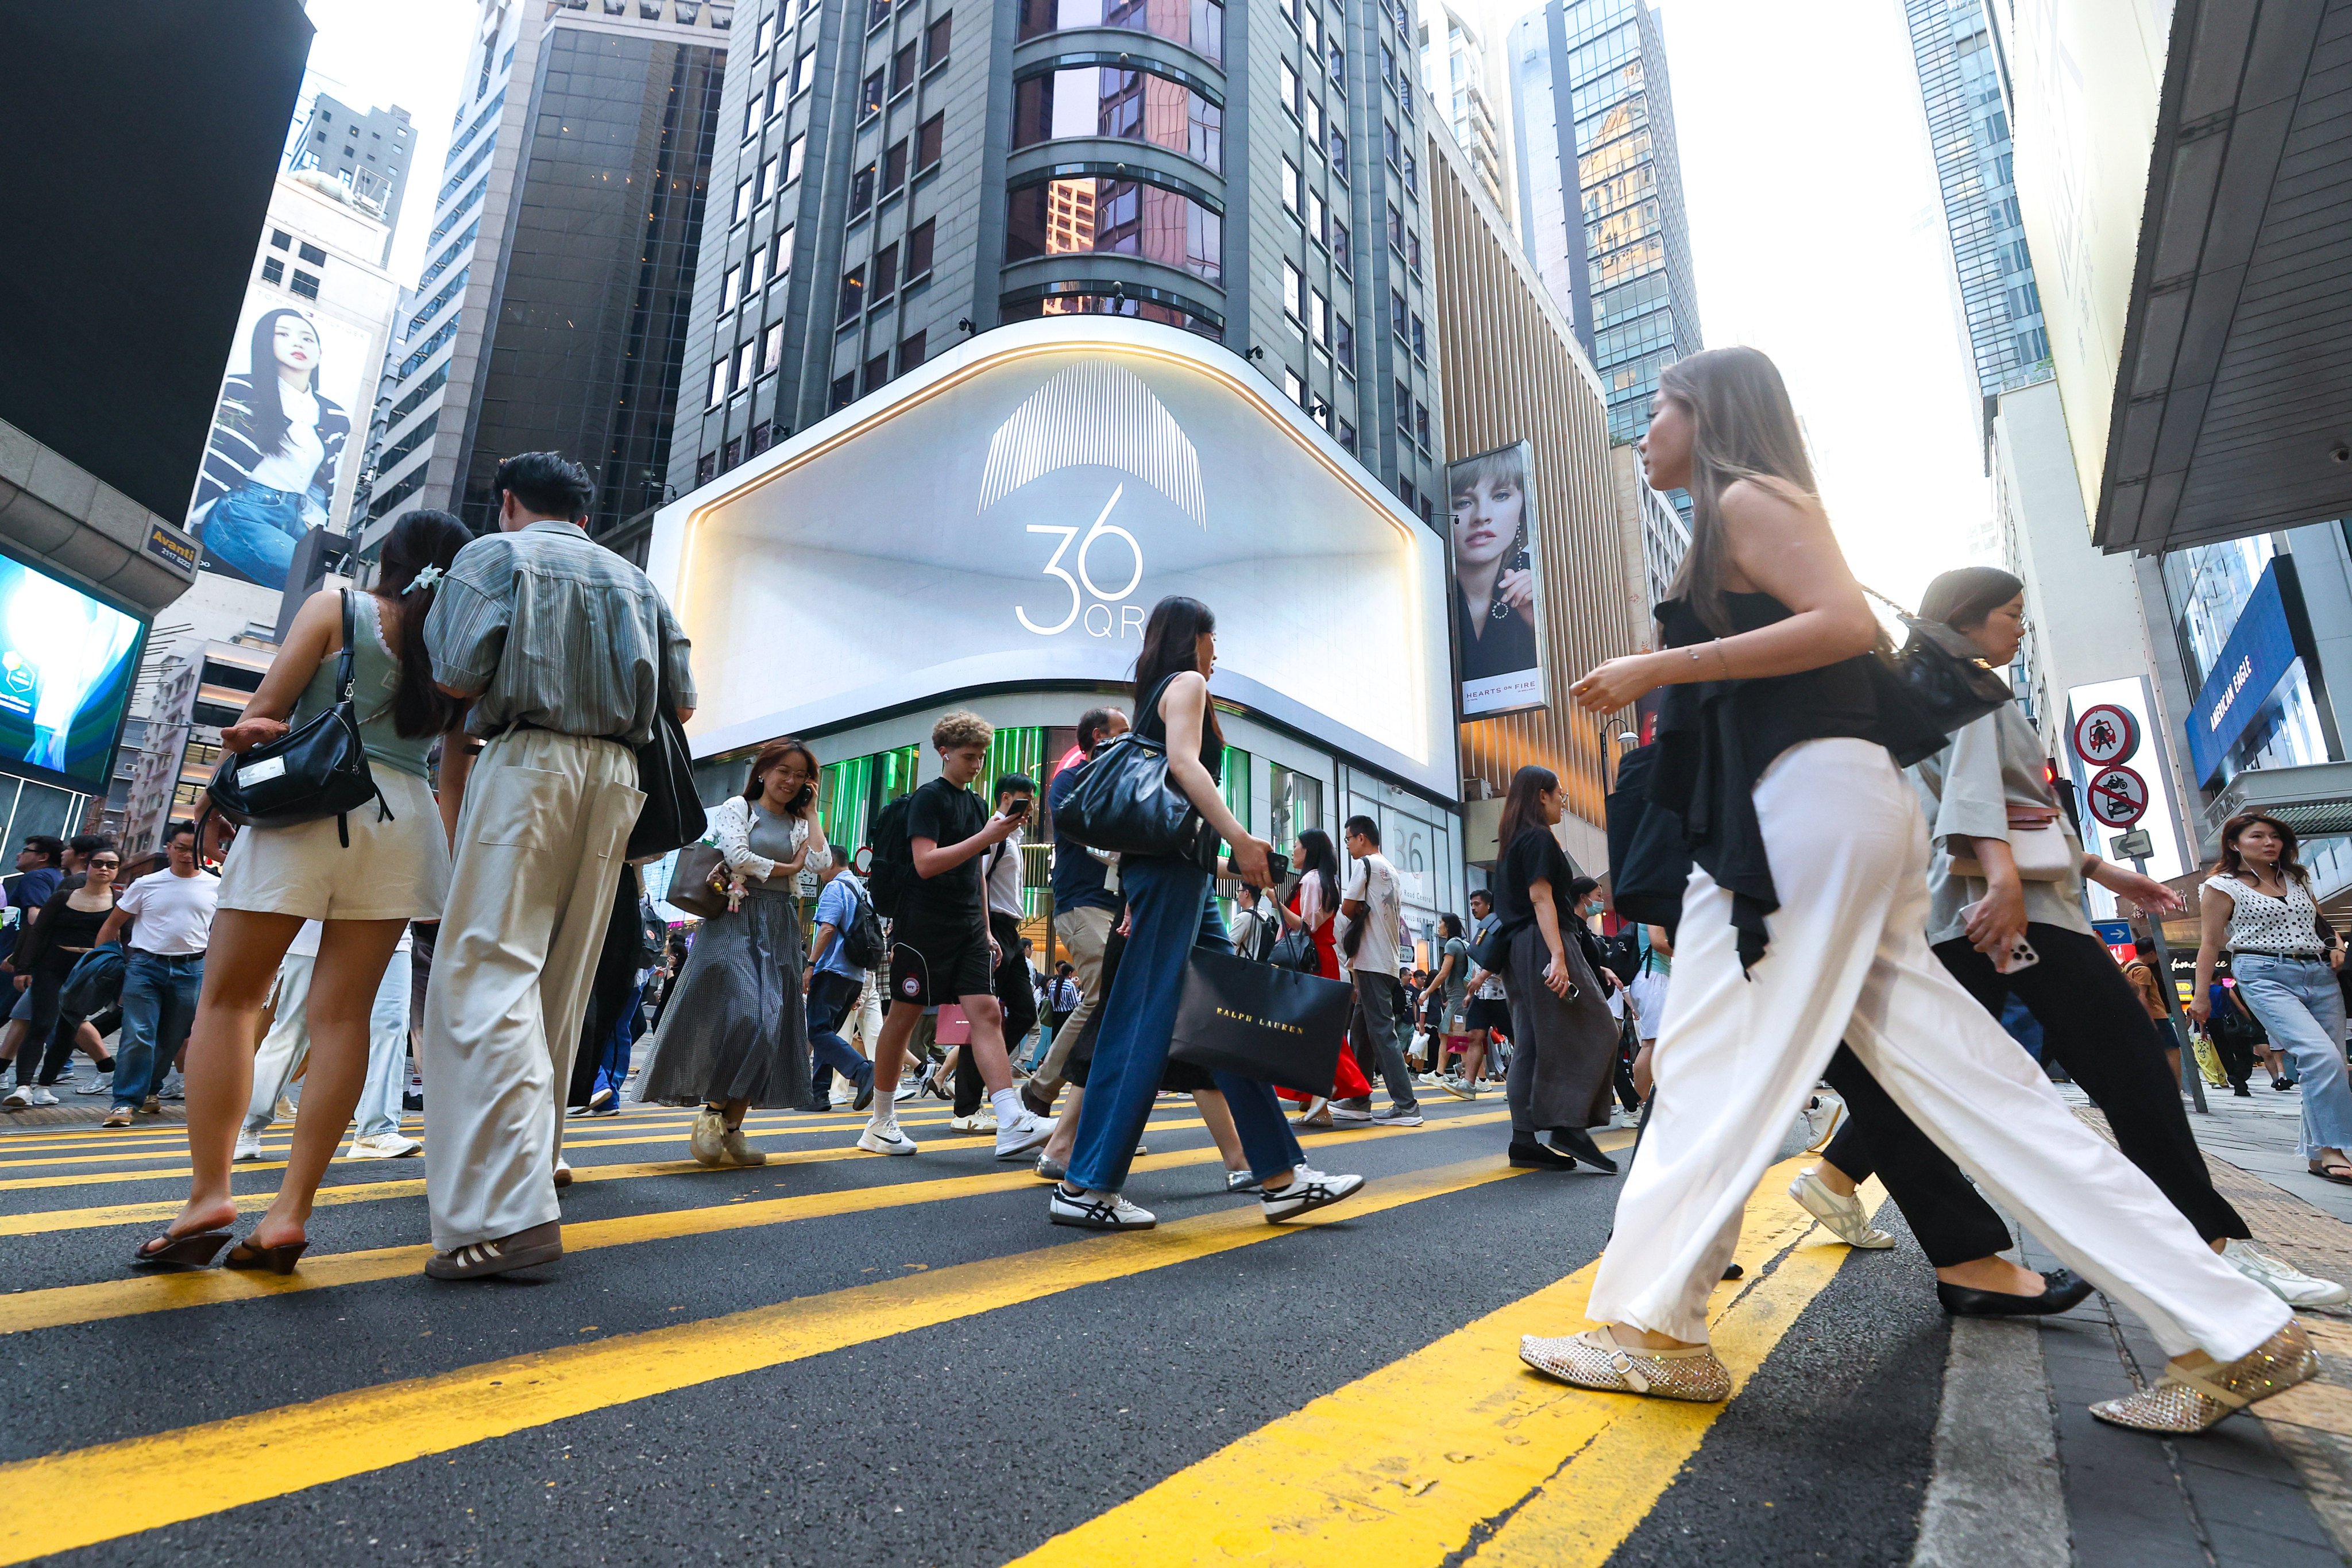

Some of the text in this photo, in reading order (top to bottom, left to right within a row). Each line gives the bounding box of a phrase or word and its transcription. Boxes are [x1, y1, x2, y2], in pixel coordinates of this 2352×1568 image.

[152, 531, 194, 561] Avanti
[1015, 481, 1144, 635] 36
[1084, 603, 1145, 640] QR
[1466, 688, 1501, 698] HEARTS
[1515, 681, 1535, 690] FIRE
[2210, 655, 2252, 732] AMERICAN EAGLE
[1393, 825, 1423, 879] 36
[1404, 889, 1415, 899] Road
[1416, 893, 1432, 903] Central
[1404, 914, 1422, 923] BUILDING
[1216, 1007, 1304, 1035] RALPH LAUREN
